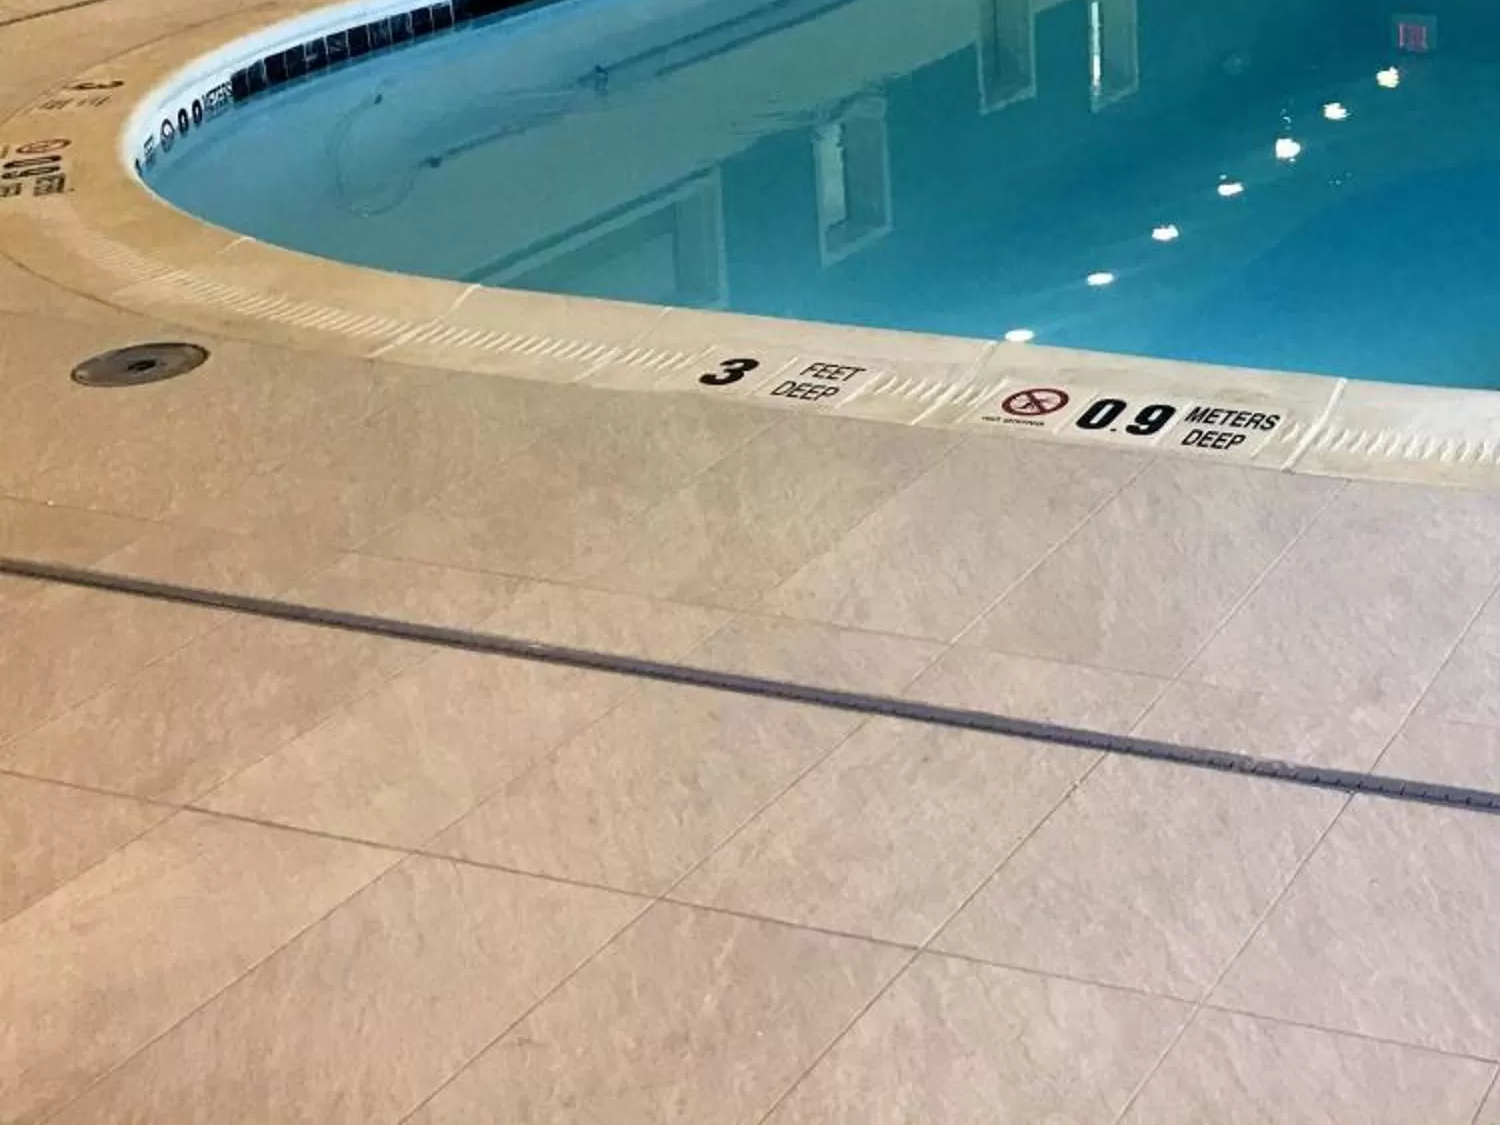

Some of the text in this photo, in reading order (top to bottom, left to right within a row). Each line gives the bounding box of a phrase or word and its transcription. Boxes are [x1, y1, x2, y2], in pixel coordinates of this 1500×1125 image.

[698, 358, 760, 386] 3
[800, 362, 867, 381] FEET
[770, 380, 840, 401] DEEP
[1075, 398, 1176, 435] 0.9
[1184, 406, 1280, 431] METERS
[1180, 428, 1246, 450] DEEP
